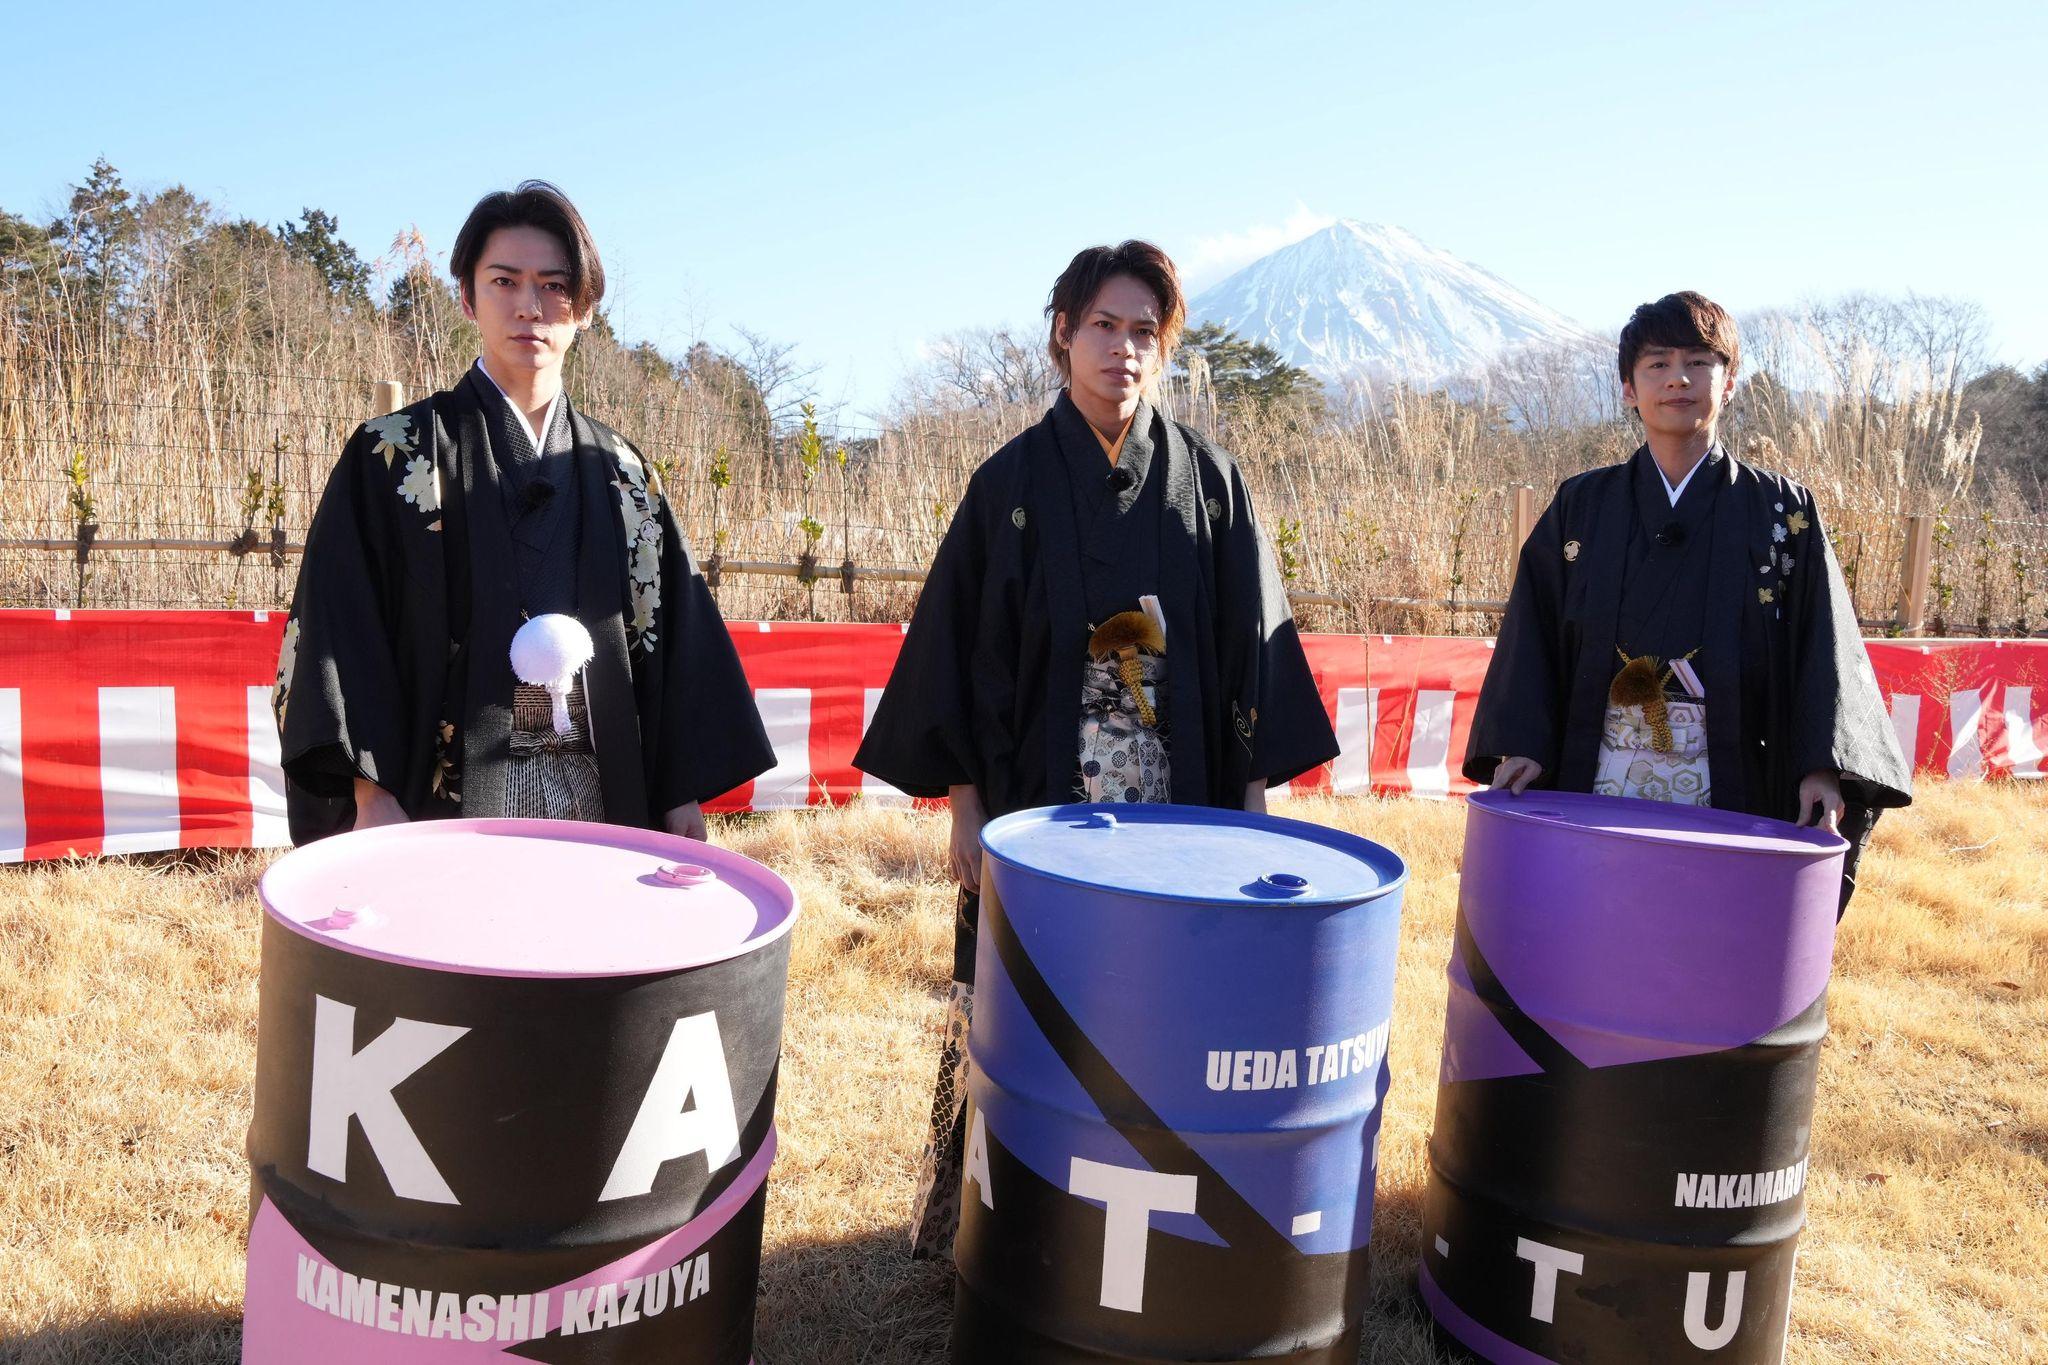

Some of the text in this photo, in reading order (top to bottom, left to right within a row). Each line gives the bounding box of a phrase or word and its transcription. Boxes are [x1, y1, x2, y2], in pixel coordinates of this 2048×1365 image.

[1206, 1050, 1297, 1091] UEDA
[1674, 1160, 1803, 1209] NAKAMARU
[297, 1252, 710, 1342] KAMENASHI KAZUYA
